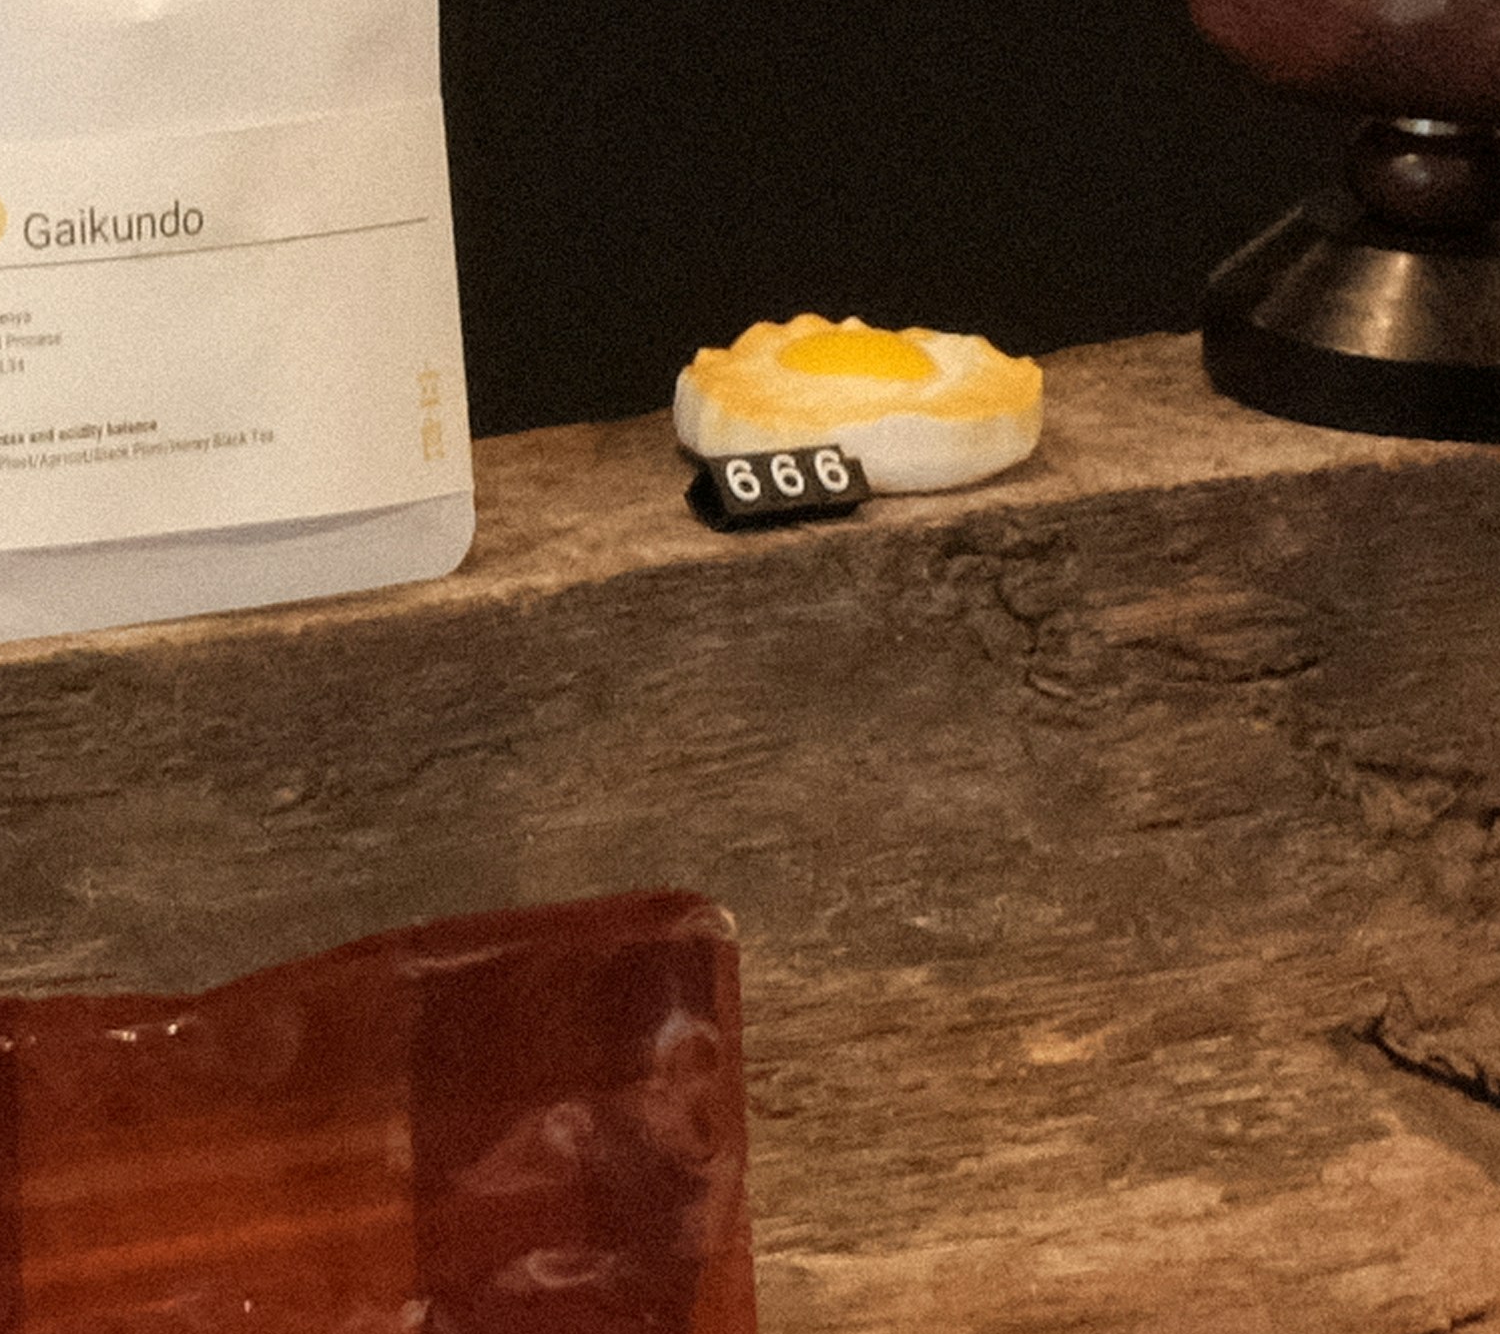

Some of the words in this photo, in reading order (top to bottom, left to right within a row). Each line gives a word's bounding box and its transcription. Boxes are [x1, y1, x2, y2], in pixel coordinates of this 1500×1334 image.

[24, 199, 205, 250] Gaikundo
[30, 428, 55, 444] and
[59, 423, 103, 444] acidity
[107, 419, 157, 436] balance
[725, 448, 850, 503] 666
